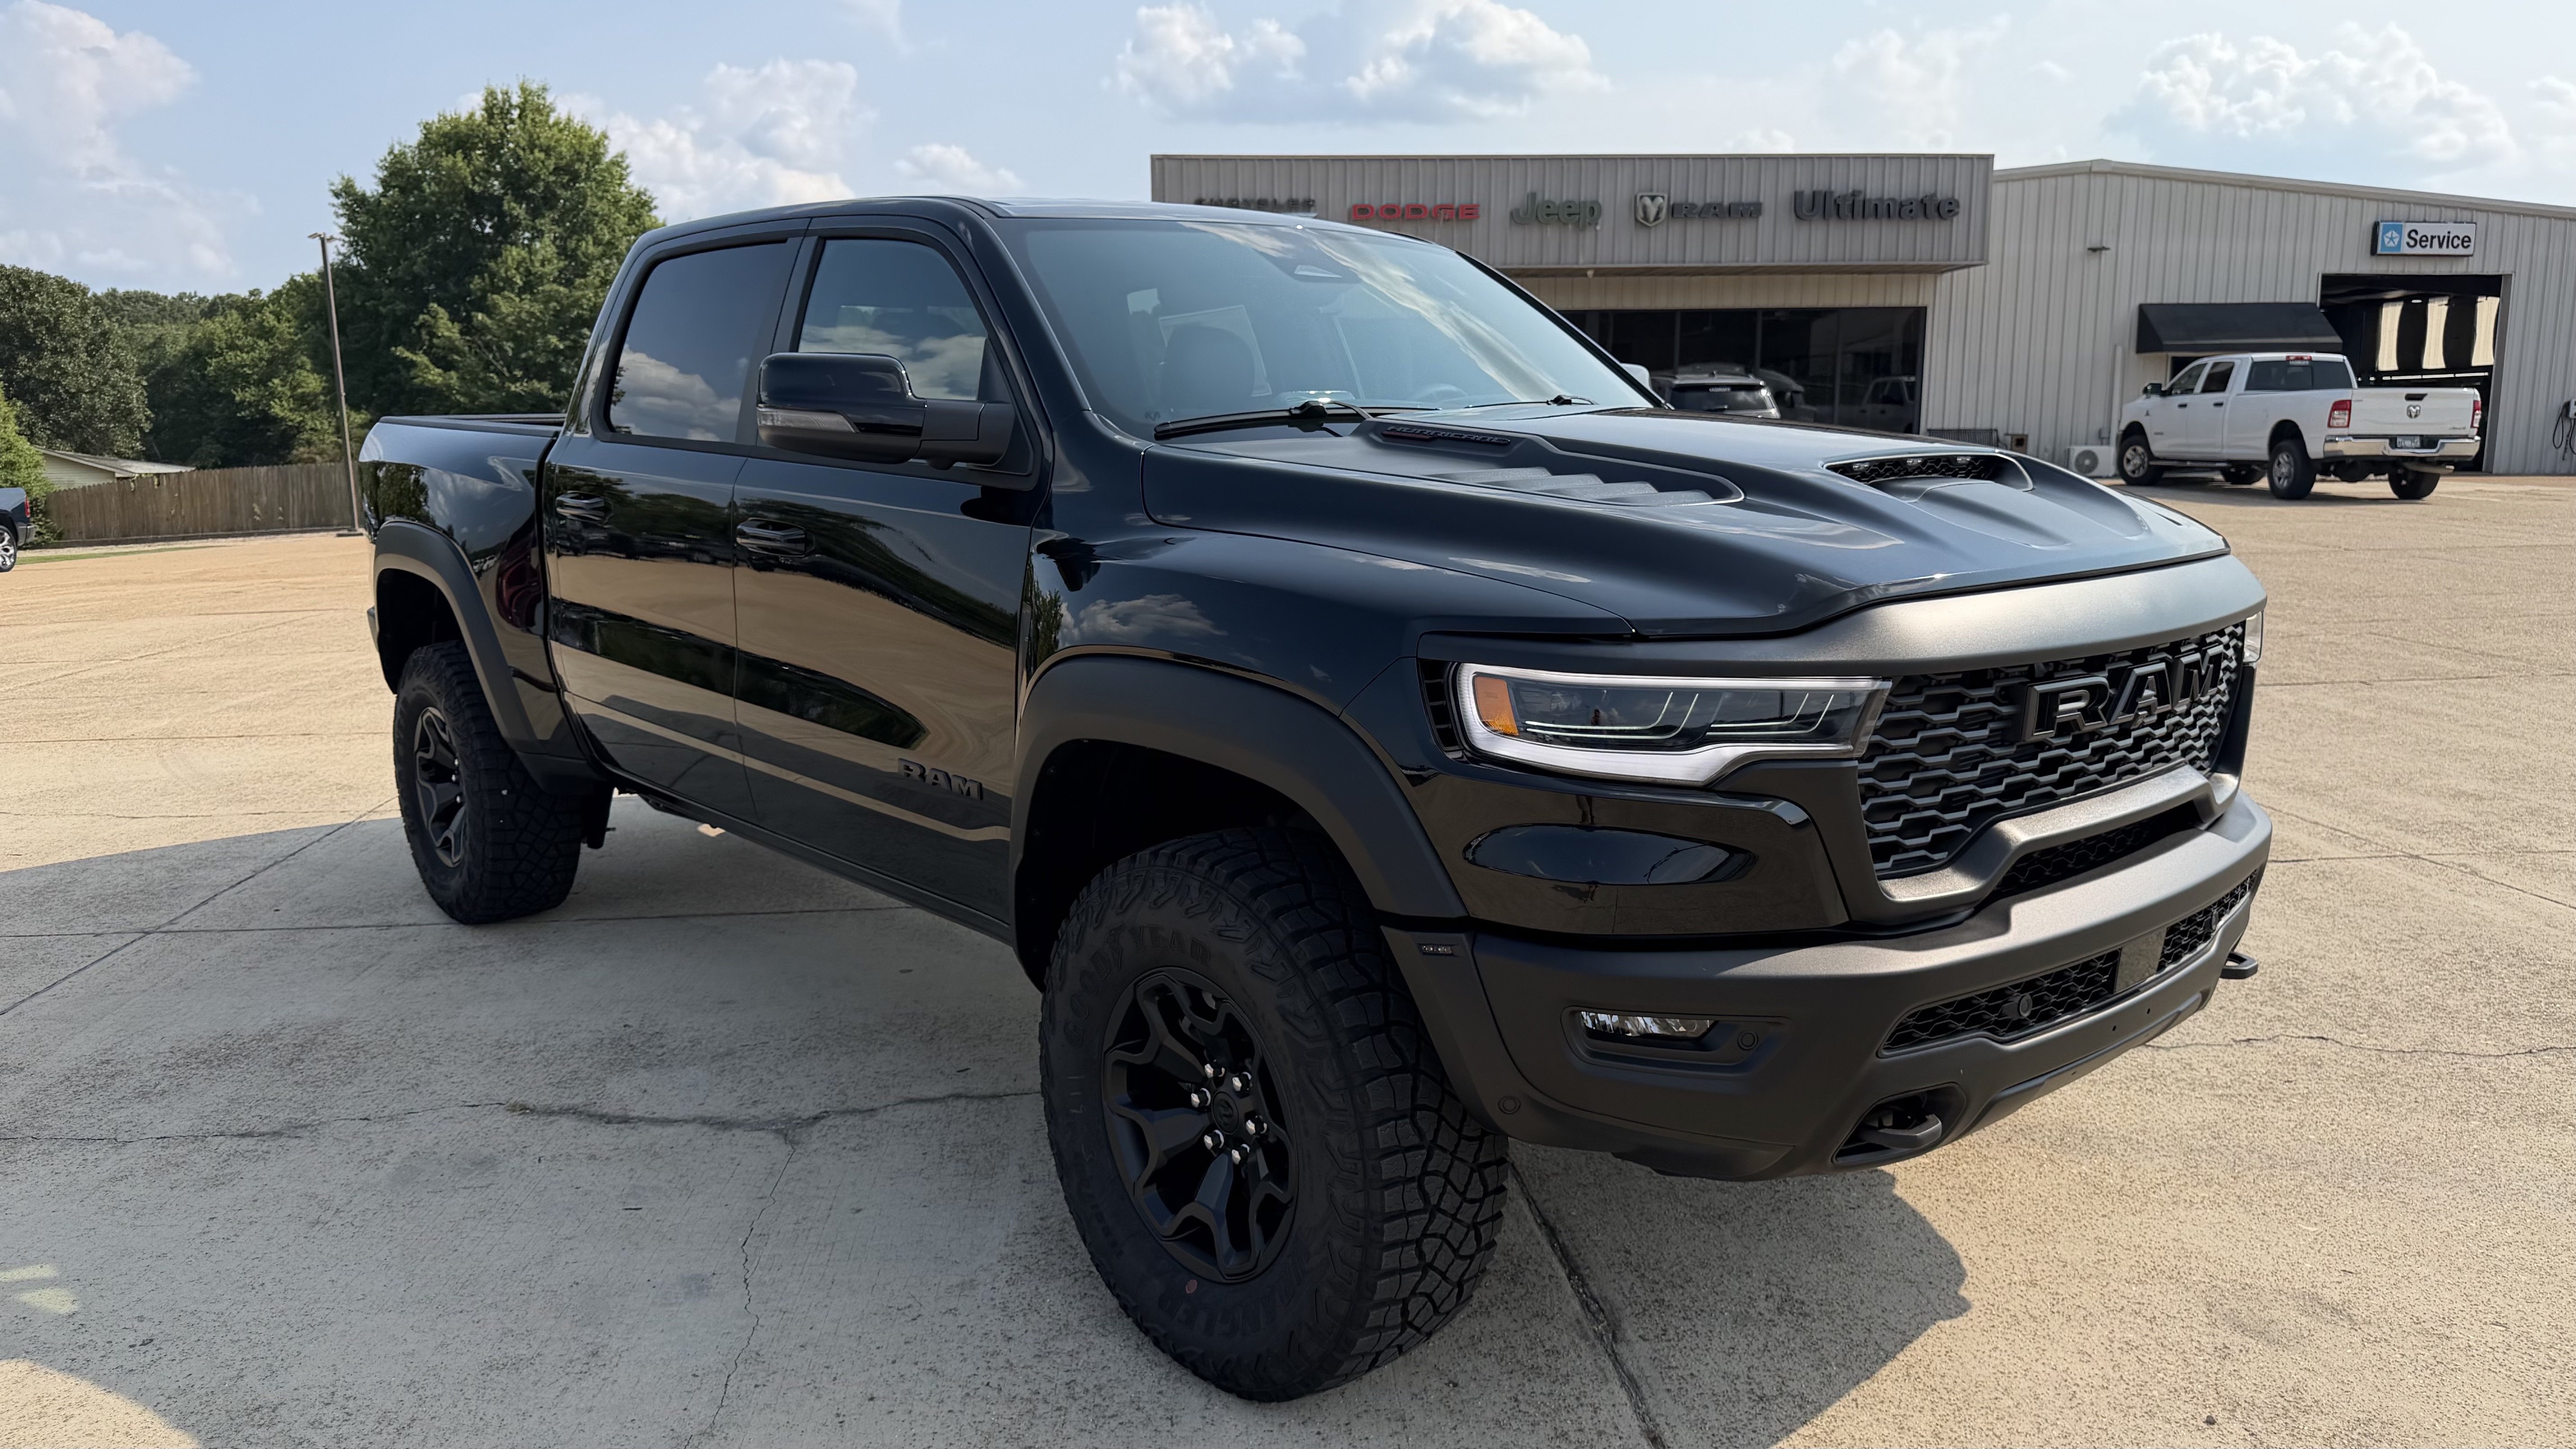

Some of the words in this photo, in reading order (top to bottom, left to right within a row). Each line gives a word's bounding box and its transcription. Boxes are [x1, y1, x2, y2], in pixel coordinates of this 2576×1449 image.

[1352, 204, 1480, 220] DODGE
[1510, 192, 1602, 231] Jeep
[1672, 202, 1762, 218] RAM
[1794, 190, 1960, 220] Ultimate
[2406, 229, 2471, 248] Service
[1386, 426, 1511, 444] HURRICANE
[2022, 644, 2224, 742] RAM
[897, 758, 984, 800] RAM
